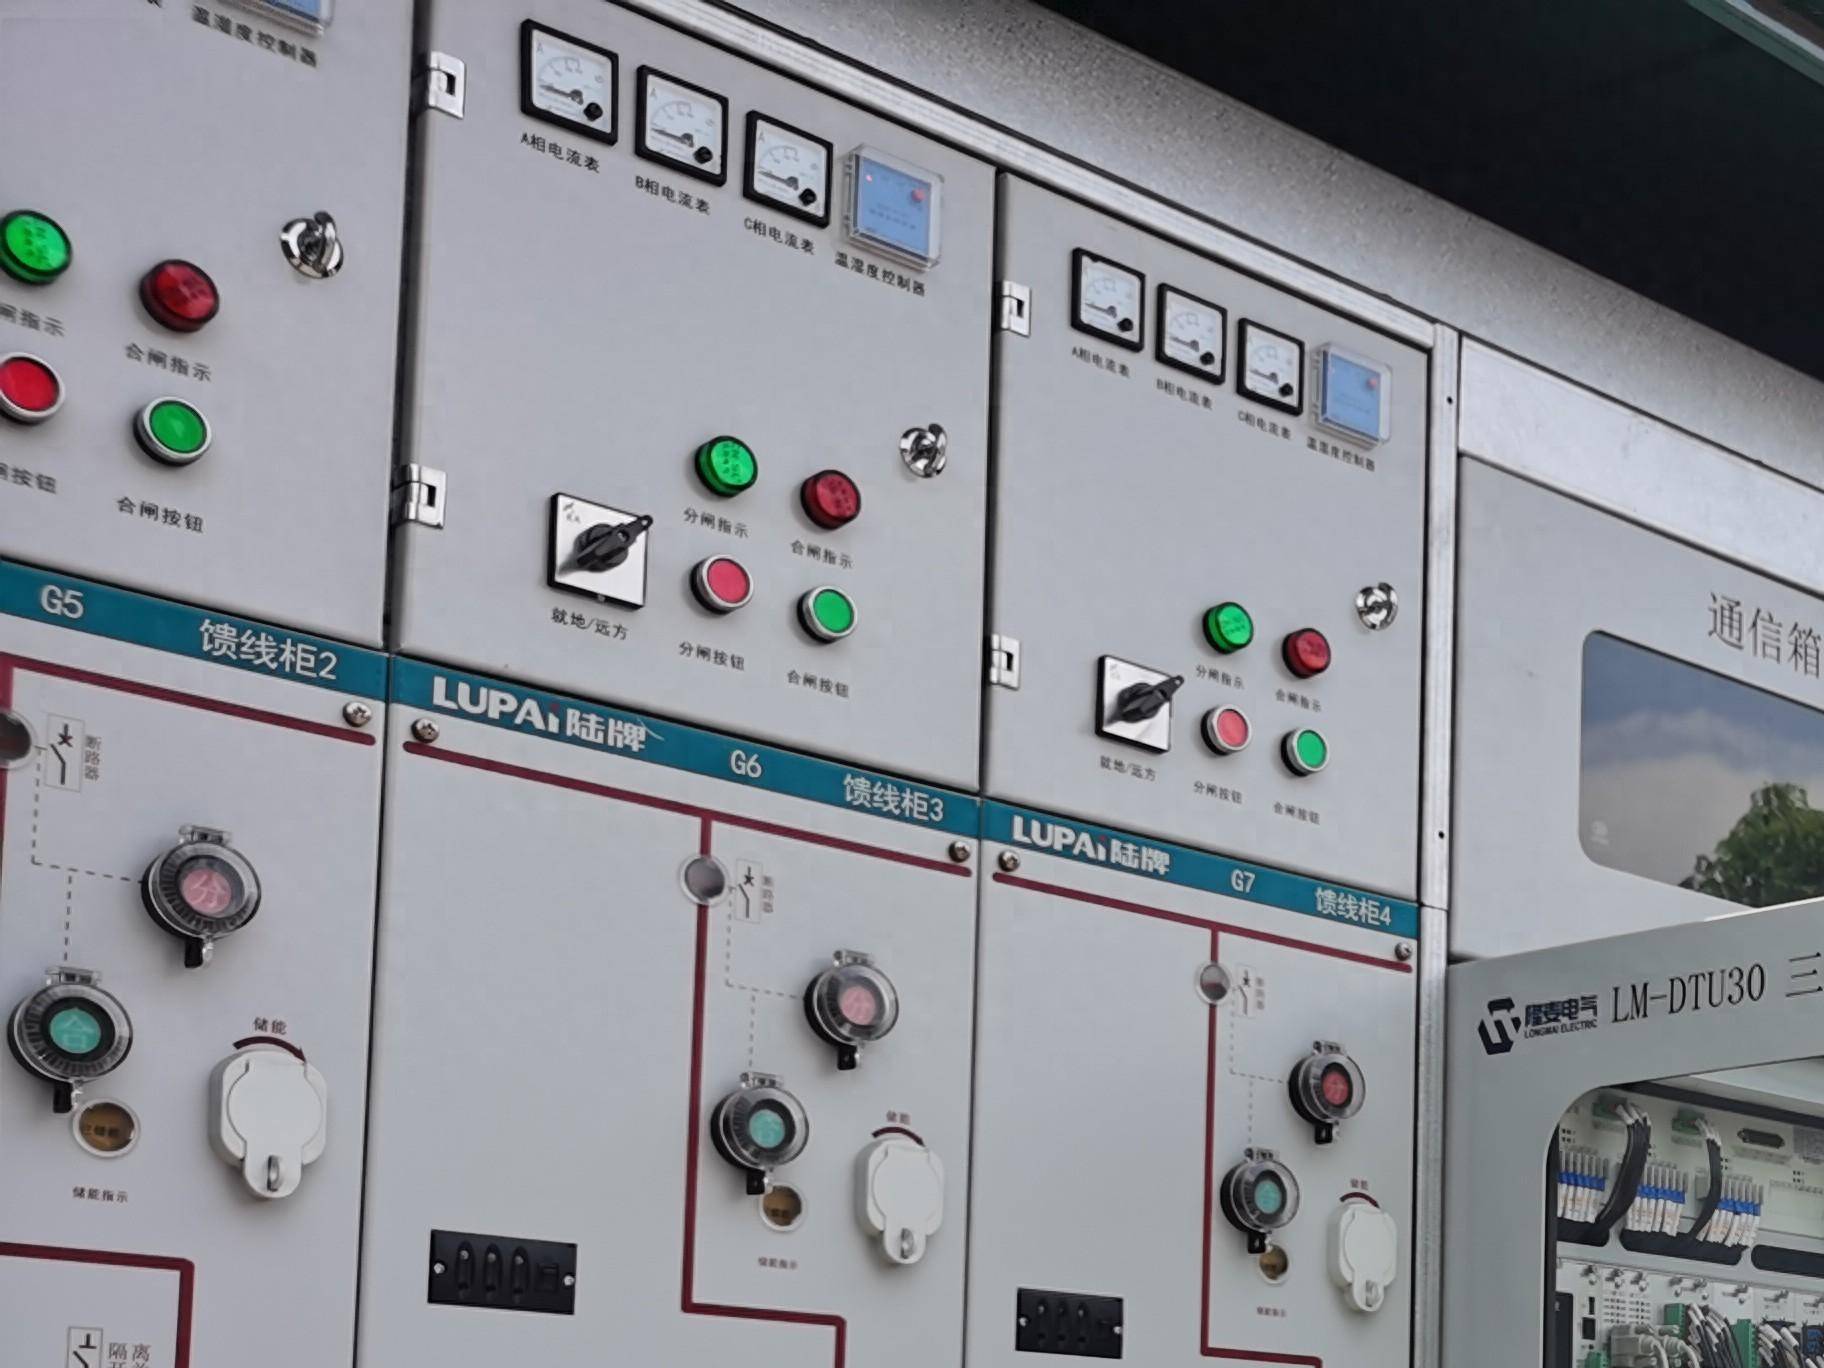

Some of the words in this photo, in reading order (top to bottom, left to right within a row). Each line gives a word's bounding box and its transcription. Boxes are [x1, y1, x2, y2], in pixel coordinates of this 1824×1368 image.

[190, 5, 318, 69] 温湿度控制器
[520, 132, 601, 174] A相电流表
[634, 174, 711, 216] B相电流表
[743, 216, 816, 256] C相电流表
[835, 251, 926, 296] 温湿度控制器
[125, 343, 212, 382] 合闸指示
[1071, 346, 1131, 379] A相电流表
[1156, 379, 1214, 411] B相电流表
[1237, 410, 1292, 441] C相电流表
[117, 496, 204, 533] 合闸按钮
[684, 507, 750, 538] 分闸指示
[790, 539, 854, 570] 合闸指示
[40, 585, 84, 619] G5
[200, 619, 337, 680] 馈线柜2
[551, 606, 629, 642] 就地/远方
[1706, 592, 1824, 678] 通信箱
[678, 640, 745, 672] 分闸按钮
[787, 669, 850, 699] 合闸按钮
[1195, 663, 1245, 690] 分闸指示
[1275, 689, 1323, 713] 合闸指示
[85, 735, 102, 781] 断路器
[566, 707, 648, 753] 陆牌
[730, 749, 762, 779] G6
[843, 774, 944, 822] 馈线柜3
[1099, 755, 1157, 783] 就地/远方
[1193, 780, 1243, 806] 分闸按钮
[1273, 801, 1321, 826] 合闸按钮
[1111, 838, 1171, 876] 陆牌
[1231, 868, 1254, 892] G7
[1315, 887, 1392, 928] 馈线柜4
[1610, 960, 1766, 1025] LM-DTU30
[53, 1008, 99, 1051] 合
[253, 1016, 288, 1036] 储能
[72, 1187, 129, 1203] 储能指示
